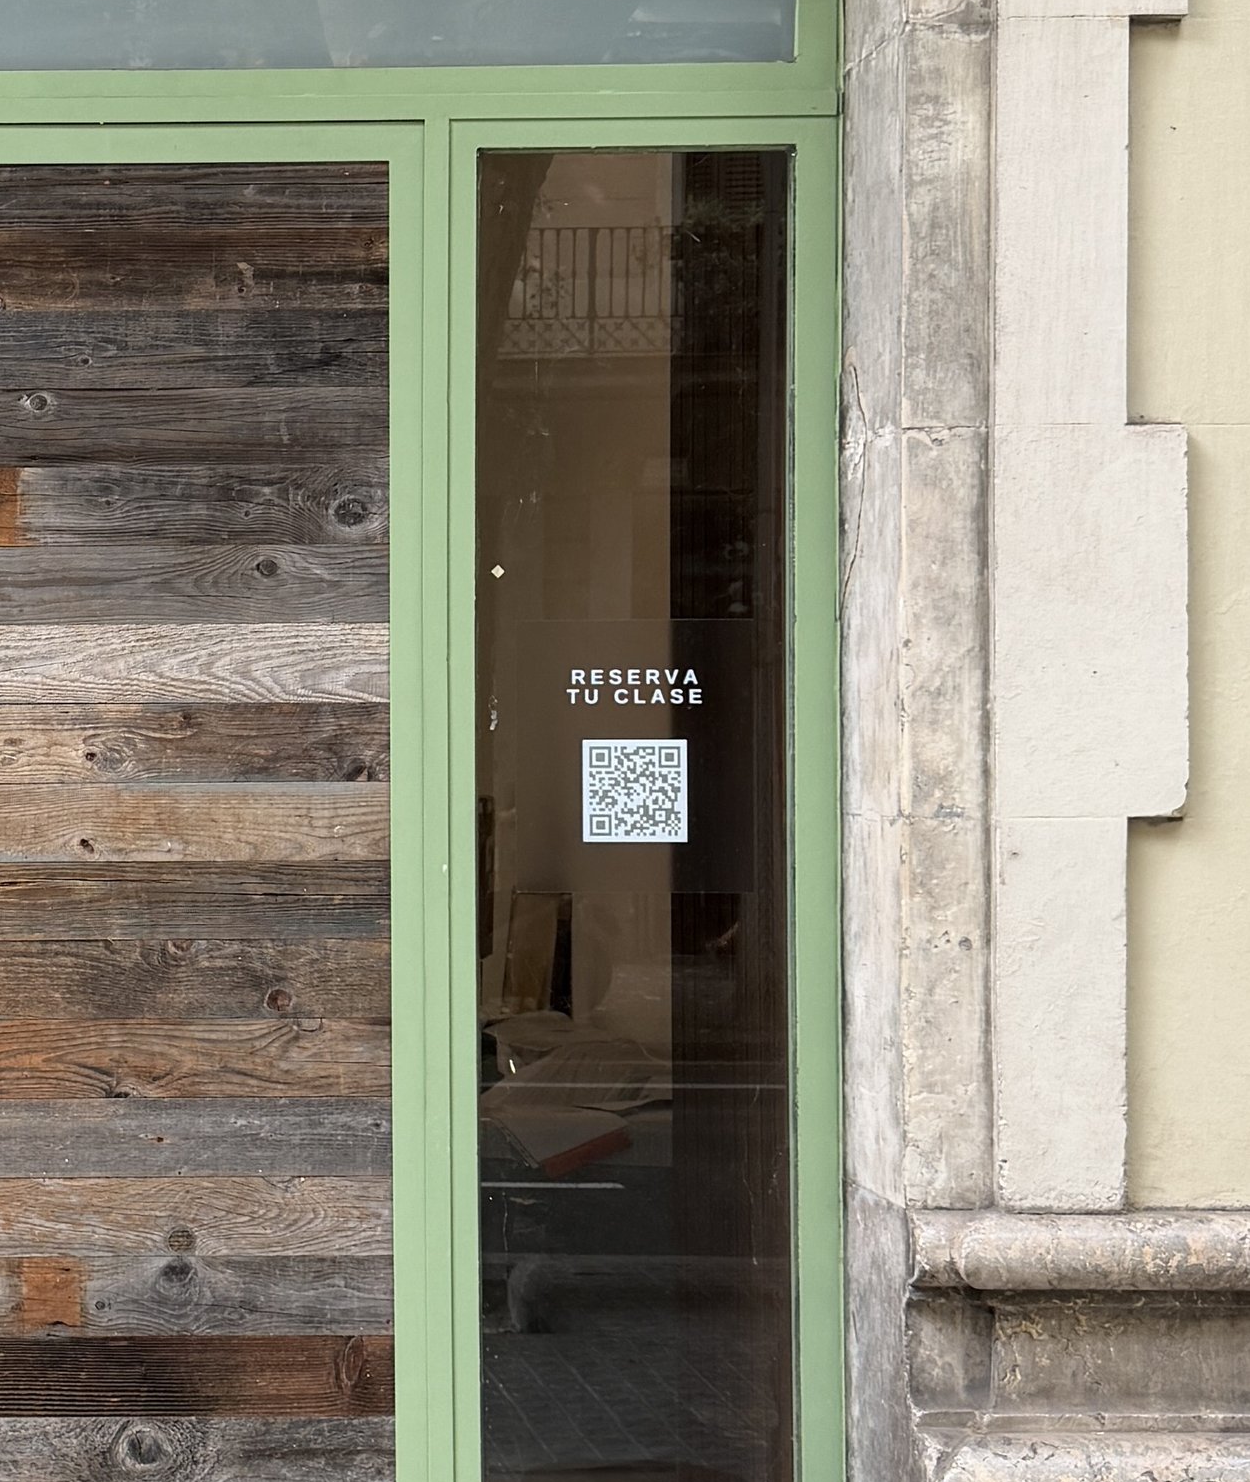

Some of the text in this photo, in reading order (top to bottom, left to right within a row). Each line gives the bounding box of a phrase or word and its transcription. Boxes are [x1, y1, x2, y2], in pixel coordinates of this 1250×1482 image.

[571, 668, 699, 686] RESERVA
[566, 688, 703, 705] TU CLASE
